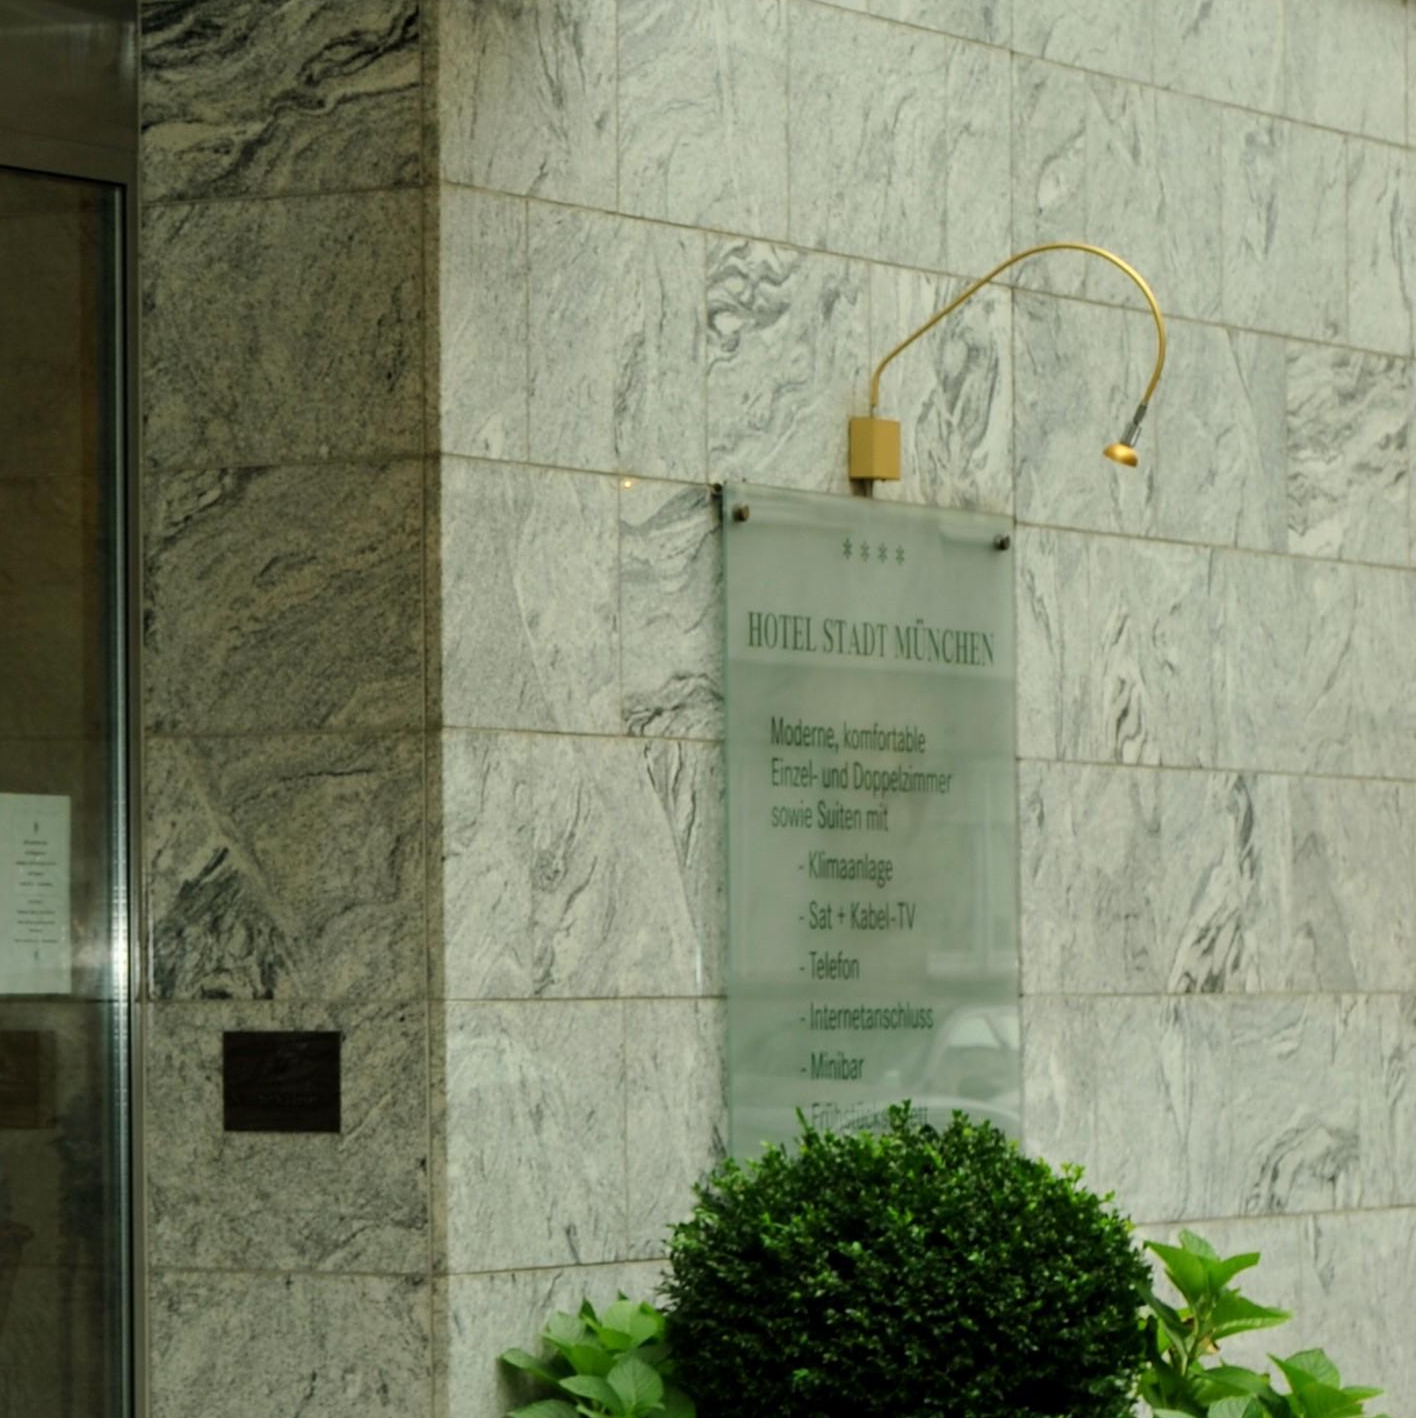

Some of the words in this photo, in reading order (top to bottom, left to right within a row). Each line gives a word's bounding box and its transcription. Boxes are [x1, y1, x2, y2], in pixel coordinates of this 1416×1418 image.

[747, 610, 817, 654] HOTEL
[822, 617, 888, 659] STADT
[894, 618, 996, 668] MÜNCHEN
[770, 715, 840, 755] Moderne,
[843, 721, 927, 754] komfortable
[771, 756, 819, 789] Einzel-
[821, 761, 849, 790] und
[853, 761, 953, 800] Doppelzimmer
[771, 798, 814, 830] sowie
[817, 799, 862, 831] Suiten
[866, 802, 889, 832] mit
[808, 850, 894, 889] Klimaanlage
[808, 900, 833, 930] Sat
[849, 901, 917, 931] Kabel-TV
[809, 950, 861, 980] Telefon
[810, 1001, 935, 1031] Internetanschluss
[810, 1051, 865, 1080] Minibar
